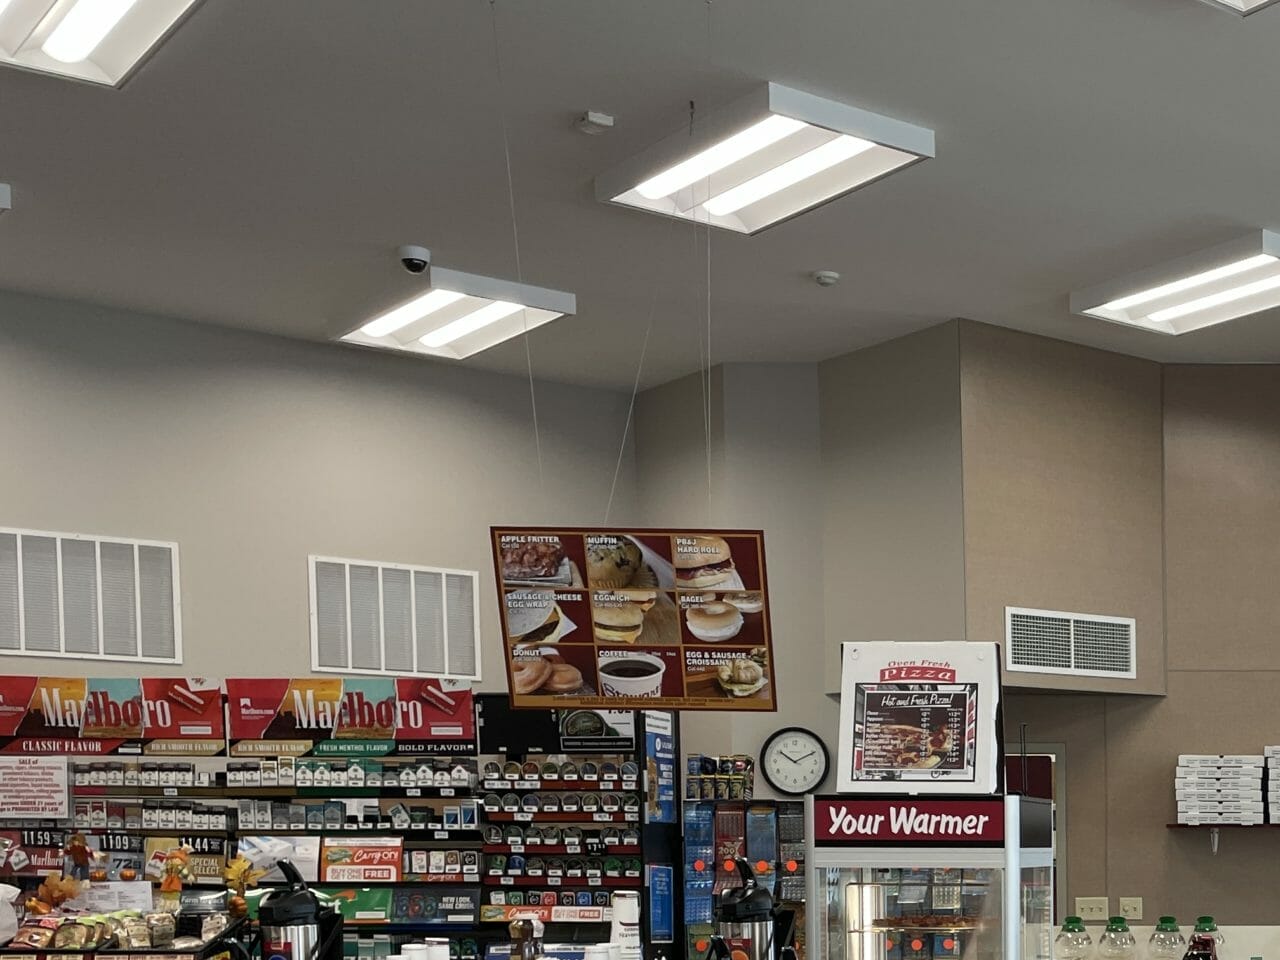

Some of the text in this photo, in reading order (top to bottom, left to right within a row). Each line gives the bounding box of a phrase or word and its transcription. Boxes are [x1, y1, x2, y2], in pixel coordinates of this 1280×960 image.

[501, 535, 560, 543] APPLE FRITTER
[587, 537, 617, 545] MUFFIN
[676, 538, 697, 546] PB&J
[677, 546, 720, 554] HARD ROLL
[507, 593, 542, 601] SAUSAGE
[552, 593, 582, 601] CHEESE
[594, 594, 630, 602] EGGWICH
[680, 595, 704, 603] BAGEL
[508, 600, 549, 609] EGG WRAP
[512, 649, 540, 657] DONUT
[598, 650, 628, 658] COFFEE
[685, 651, 701, 659] EGG
[703, 651, 710, 659] &
[686, 658, 730, 666] CROISSANT
[888, 660, 951, 668] Oven Fresh
[884, 668, 952, 681] Pizza
[881, 694, 895, 707] Hot
[896, 697, 910, 706] and
[910, 694, 929, 706] Fresh
[40, 687, 172, 728] Marlboro
[292, 688, 424, 730] Marlboro
[22, 740, 102, 752] CLASSIC FLAVOR
[319, 744, 388, 752] FRESH MENTHOL FLAVOR
[398, 744, 467, 752] BOLD FLAVOR
[829, 806, 988, 835] Your Warmer
[31, 850, 64, 866] Marlboro
[191, 857, 218, 866] SPECIAL
[193, 866, 220, 875] SELECT
[346, 868, 362, 876] ONE
[365, 869, 390, 879] FREE
